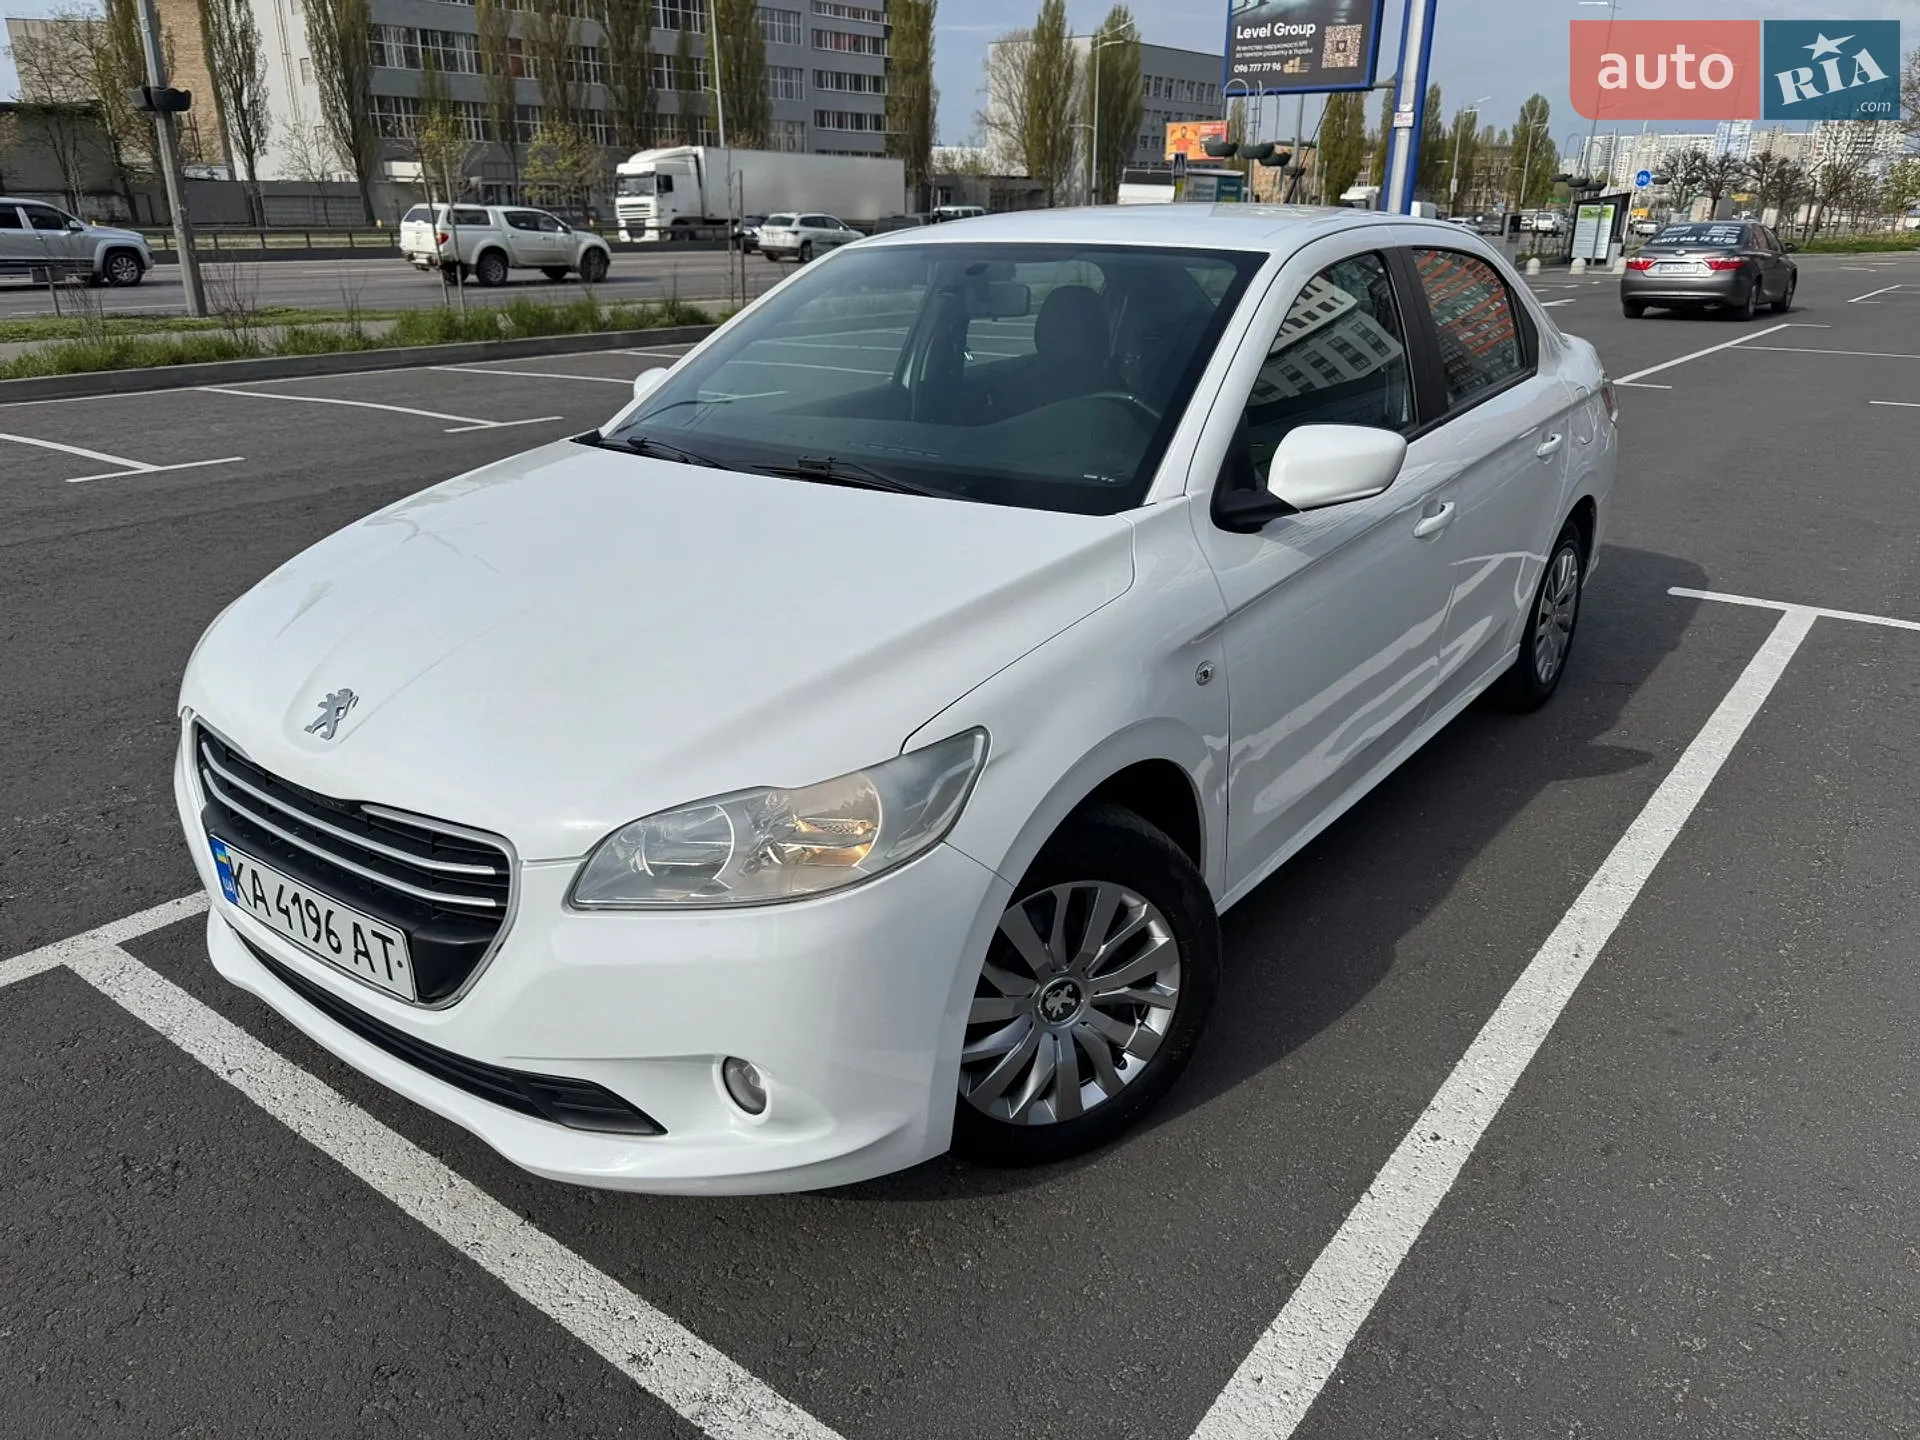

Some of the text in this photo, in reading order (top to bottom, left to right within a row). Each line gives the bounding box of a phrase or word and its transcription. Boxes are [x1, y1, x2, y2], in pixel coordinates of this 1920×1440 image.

[1237, 22, 1316, 39] Level Group
[1234, 64, 1249, 73] 096
[227, 856, 395, 981] KA 4196 AT
